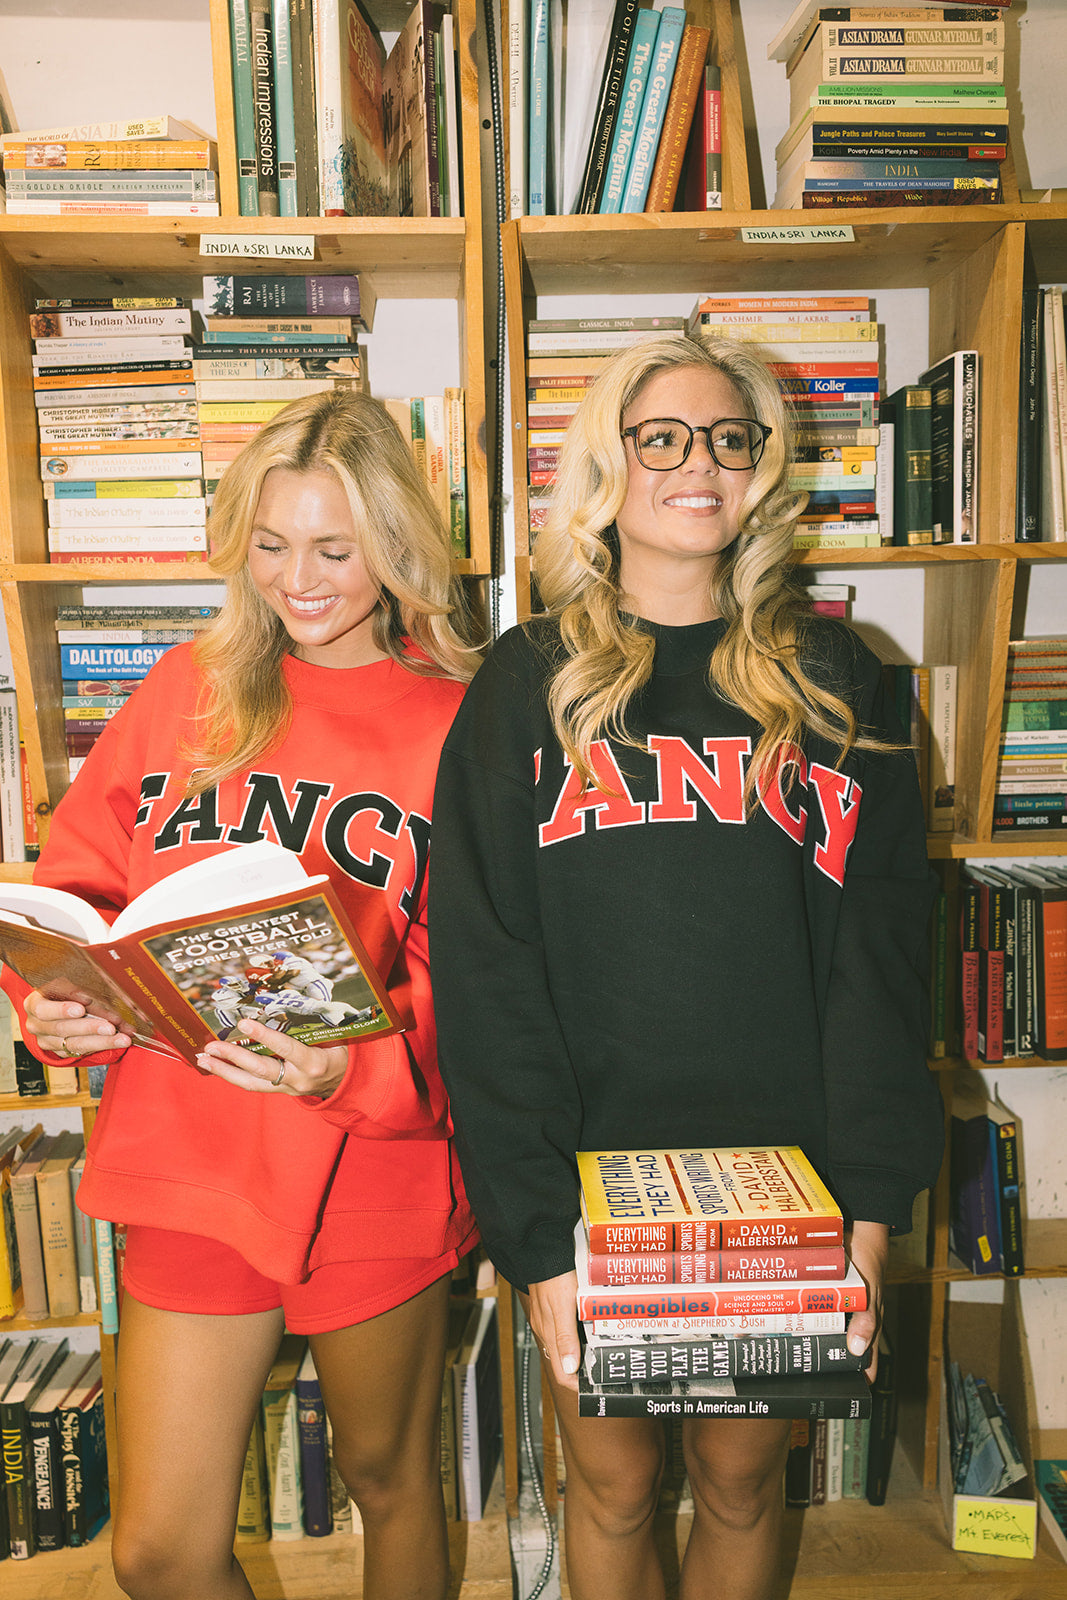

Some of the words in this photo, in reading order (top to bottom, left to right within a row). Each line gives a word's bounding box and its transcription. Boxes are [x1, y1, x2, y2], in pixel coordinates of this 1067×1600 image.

[278, 19, 288, 70] MAHAL
[510, 23, 519, 57] DELHI
[841, 31, 869, 43] ASIAN
[873, 31, 903, 43] DRAMA
[905, 31, 940, 43] GUNNAR
[942, 31, 981, 43] MYRDAL
[256, 28, 271, 77] Indian
[632, 42, 651, 74] The
[656, 40, 674, 72] The
[842, 59, 871, 73] ASIAN
[874, 60, 905, 73] DRAMA
[906, 59, 941, 72] GUNNAR
[943, 59, 981, 72] MYRDAL
[510, 77, 519, 108] Portrait
[621, 79, 643, 126] Great
[647, 76, 667, 124] Great
[127, 129, 145, 137] SAVES
[128, 123, 144, 131] USED
[256, 81, 277, 176] impressions
[674, 102, 688, 147] INDIAN
[820, 130, 841, 139] Jungle
[896, 130, 926, 138] Treasures
[608, 129, 633, 200] Moghuls
[630, 127, 657, 197] Moghuls
[847, 147, 868, 155] Poverty
[919, 149, 937, 157] New
[940, 149, 961, 157] India
[662, 153, 678, 205] SUMMER
[885, 164, 919, 177] INDIA
[26, 183, 64, 191] GOLDEN
[69, 183, 104, 191] ORIOLE
[747, 231, 778, 239] INDIA
[787, 230, 805, 238] SRI
[811, 230, 846, 238] LANKA
[206, 243, 239, 254] INDIA
[251, 243, 269, 254] SRI
[275, 245, 312, 256] LANKA
[243, 286, 253, 305] RAJ
[269, 292, 273, 300] OF
[66, 316, 86, 327] The
[90, 316, 123, 326] Indian
[126, 315, 165, 326] Mutiny
[815, 380, 846, 391] Koller
[965, 364, 973, 440] UNTOUCHABLES
[70, 649, 164, 665] DALITOLOGY
[534, 734, 863, 889] ANCY
[1017, 817, 1049, 825] BROTHERS
[166, 917, 326, 963] FOOTBALL
[175, 932, 210, 946] THE
[215, 912, 299, 937] GREATEST
[173, 952, 240, 972] STORIES
[243, 941, 288, 956] EVER
[288, 929, 332, 945] TOLD
[965, 958, 977, 1029] BARBARIANS
[991, 957, 1002, 1029] BARBARIANS
[312, 1026, 352, 1036] GRIDIRON
[353, 1018, 380, 1028] GLORY
[636, 1154, 661, 1180] HAD
[679, 1152, 715, 1184] WRITING
[597, 1154, 645, 1218] EVERYTHING
[719, 1172, 738, 1192] FROM
[733, 1162, 770, 1201] DAVID
[748, 1151, 800, 1212] HALBERSTAM
[644, 1181, 675, 1217] THEY
[692, 1184, 729, 1215] SPORTS
[606, 1226, 666, 1242] EVERYTHING
[680, 1223, 693, 1251] SPORTS
[695, 1222, 707, 1251] WRITING
[728, 1235, 798, 1247] HALBERSTAM
[740, 1224, 786, 1236] DAVID
[607, 1243, 639, 1253] THEY
[641, 1242, 666, 1252] HAD
[99, 1245, 115, 1304] Moghuls
[607, 1258, 666, 1273] EVERYTHING
[680, 1255, 693, 1283] SPORTS
[695, 1253, 707, 1283] WRITING
[727, 1270, 798, 1279] HALBERSTAM
[740, 1258, 785, 1269] DAVID
[608, 1275, 639, 1284] THEY
[641, 1274, 666, 1283] HAD
[592, 1297, 710, 1318] intangibles
[807, 1294, 834, 1302] JOAN
[617, 1316, 669, 1330] SHOWDOWN
[671, 1319, 682, 1328] at
[683, 1315, 735, 1330] SHEPHERD'S
[739, 1315, 765, 1329] BUSH
[609, 1352, 625, 1379] IT'S
[630, 1348, 647, 1379] HOW
[651, 1350, 668, 1377] YOU
[671, 1346, 688, 1378] PLAY
[692, 1347, 709, 1374] THE
[713, 1340, 729, 1377] GAME
[793, 1344, 801, 1368] BRIAN
[803, 1336, 811, 1372] KILMEADE
[597, 1397, 606, 1416] Davies
[647, 1400, 681, 1415] Sports
[684, 1400, 694, 1413] in
[696, 1400, 747, 1414] American
[749, 1400, 769, 1414] Life
[61, 1412, 77, 1453] Sepoy
[2, 1429, 24, 1484] INDIA
[33, 1436, 51, 1510] VENGEANCE
[62, 1454, 80, 1512] Cossack
[974, 1510, 1010, 1522] MAPS
[959, 1526, 977, 1539] Mt
[983, 1530, 1030, 1545] Everest
